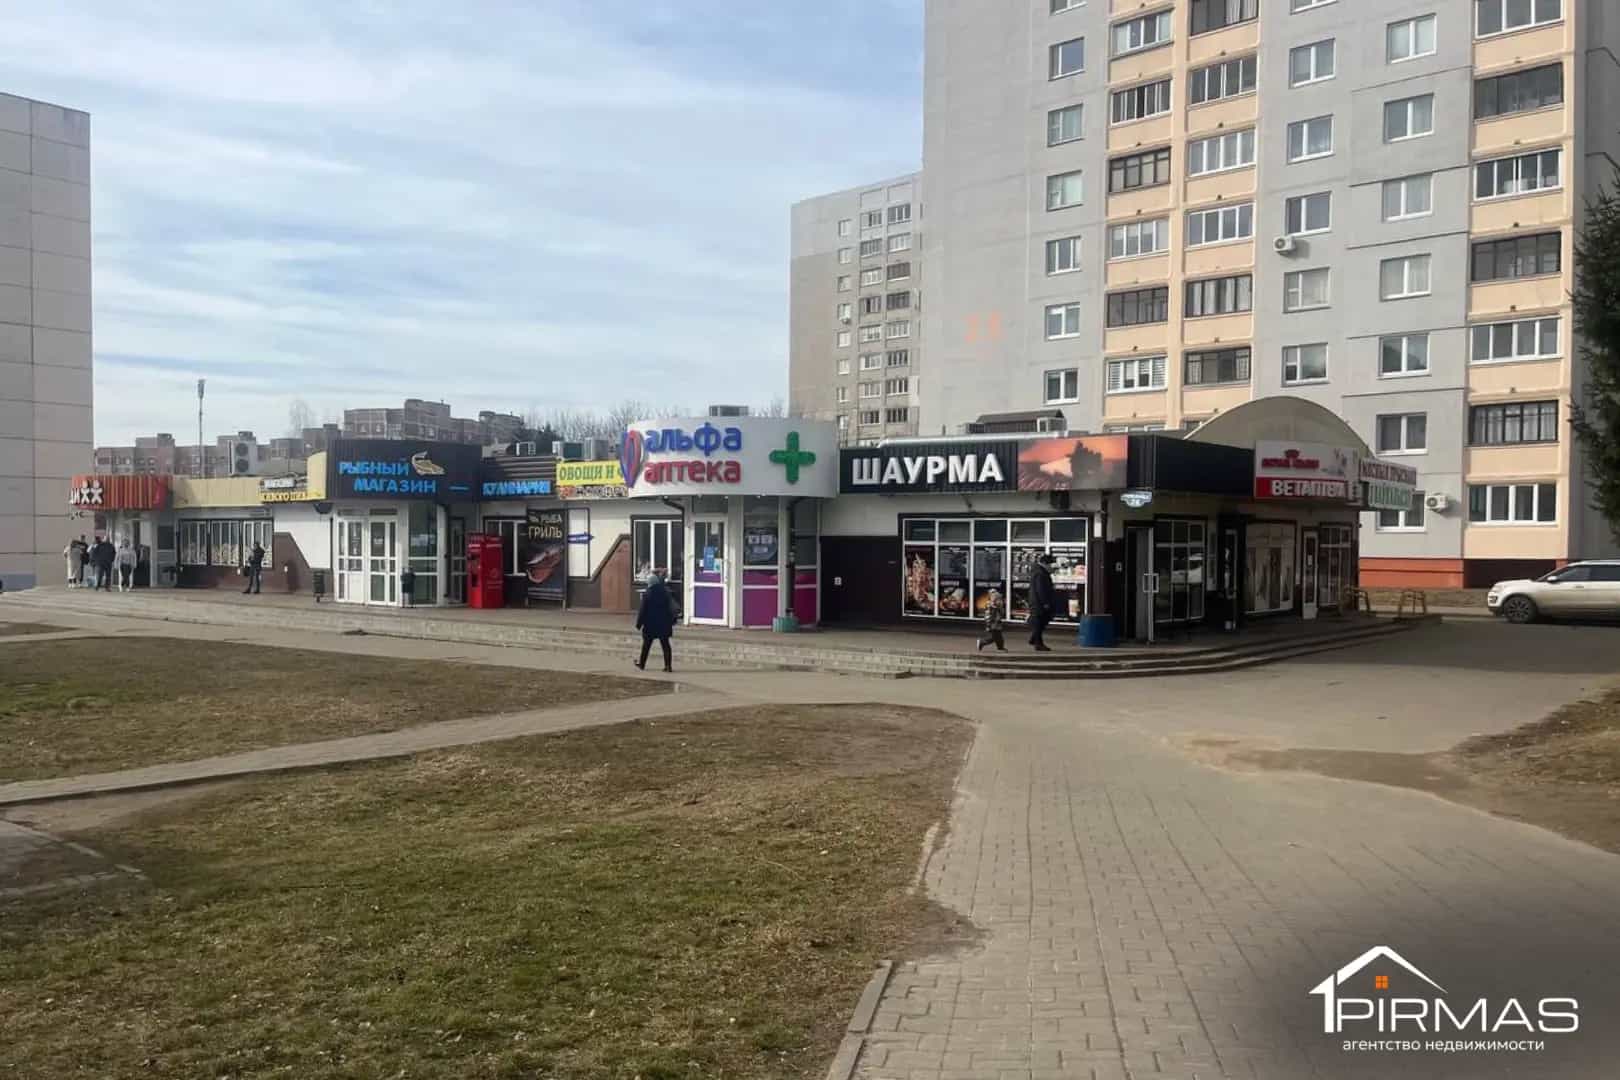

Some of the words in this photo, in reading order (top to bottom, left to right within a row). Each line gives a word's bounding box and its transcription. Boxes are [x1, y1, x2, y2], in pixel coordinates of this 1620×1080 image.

[646, 422, 742, 456] альфа
[339, 458, 410, 476] РЫБНЫЙ
[559, 465, 602, 481] ОВОЩИ
[606, 464, 614, 479] И
[644, 459, 741, 484] аптека
[852, 452, 1005, 485] ШАУРМА
[353, 478, 437, 493] МАГАЗИН
[528, 526, 563, 540] ГРИЛЬ
